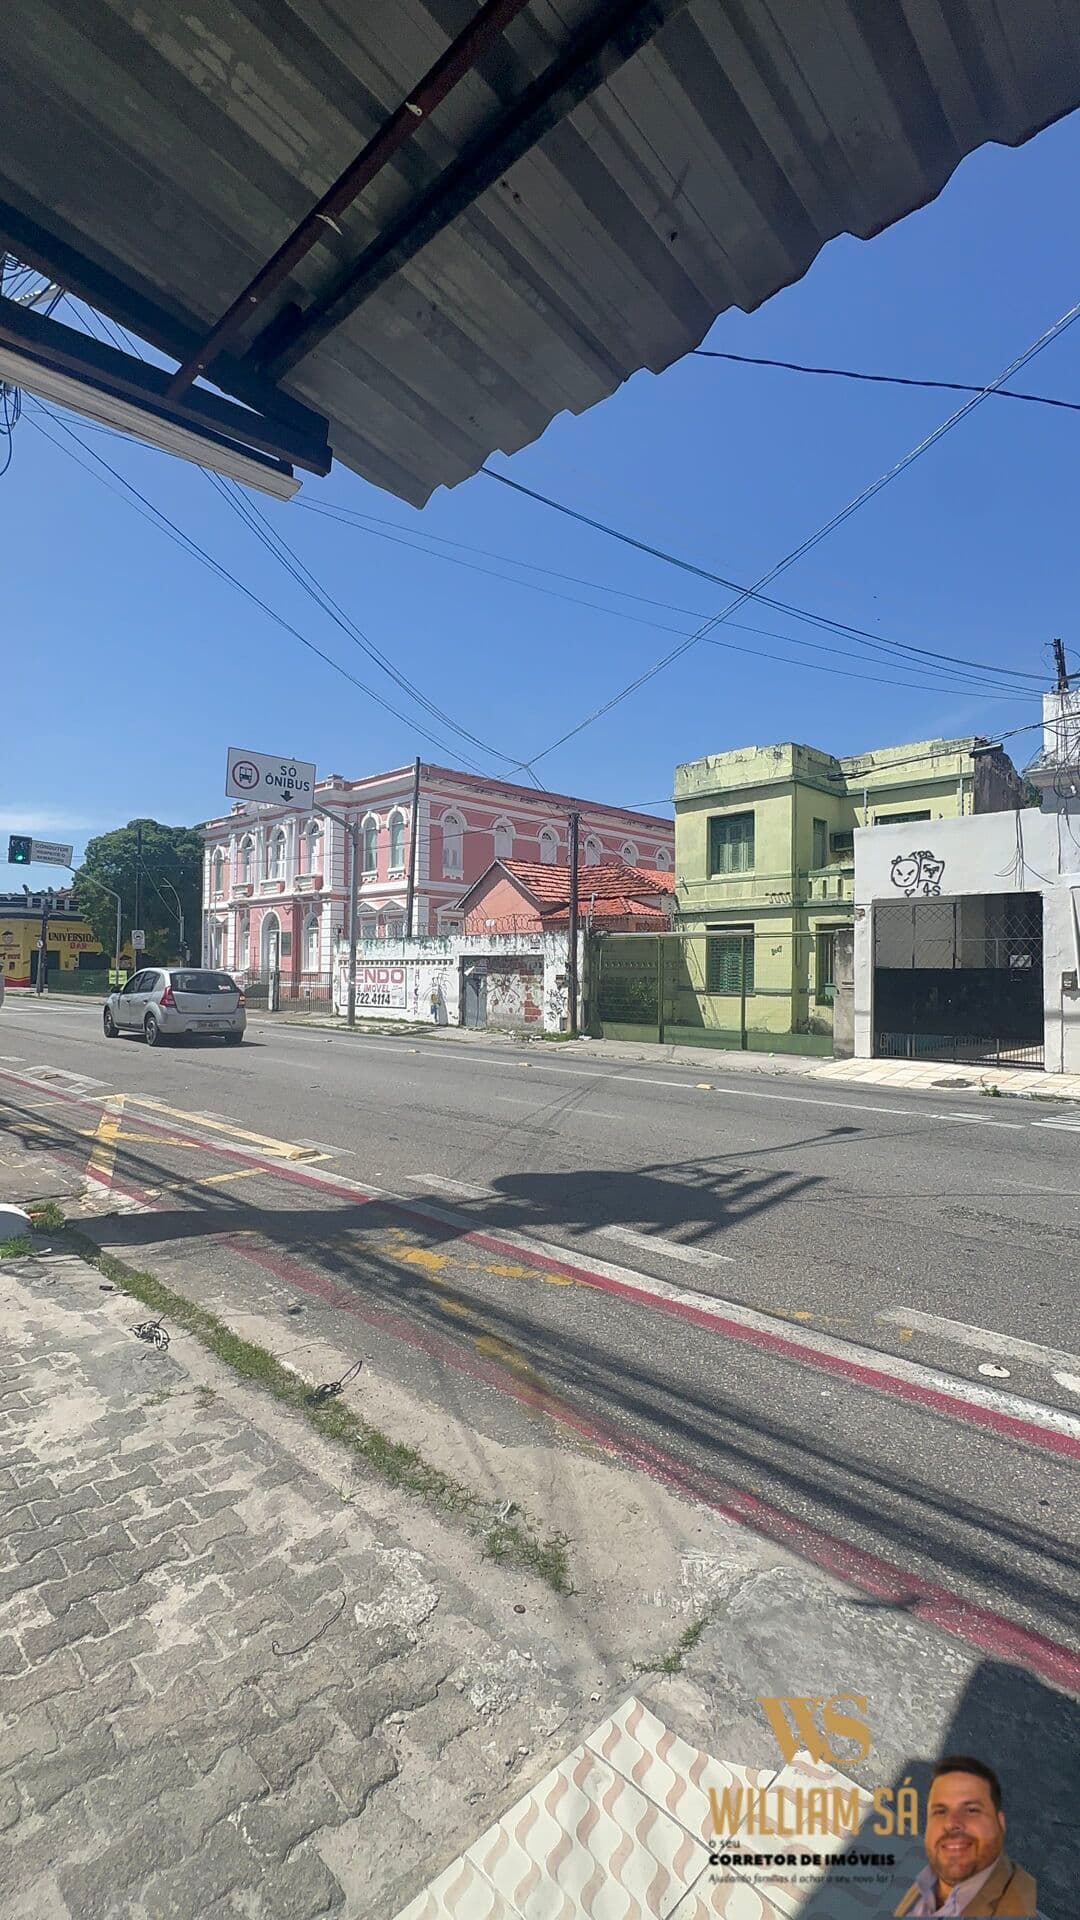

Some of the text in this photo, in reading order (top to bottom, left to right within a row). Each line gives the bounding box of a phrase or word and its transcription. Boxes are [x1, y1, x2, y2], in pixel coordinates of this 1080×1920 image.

[280, 765, 297, 778] SÓ
[265, 773, 310, 792] ÔNIBUS
[356, 993, 391, 1005] 722.4114
